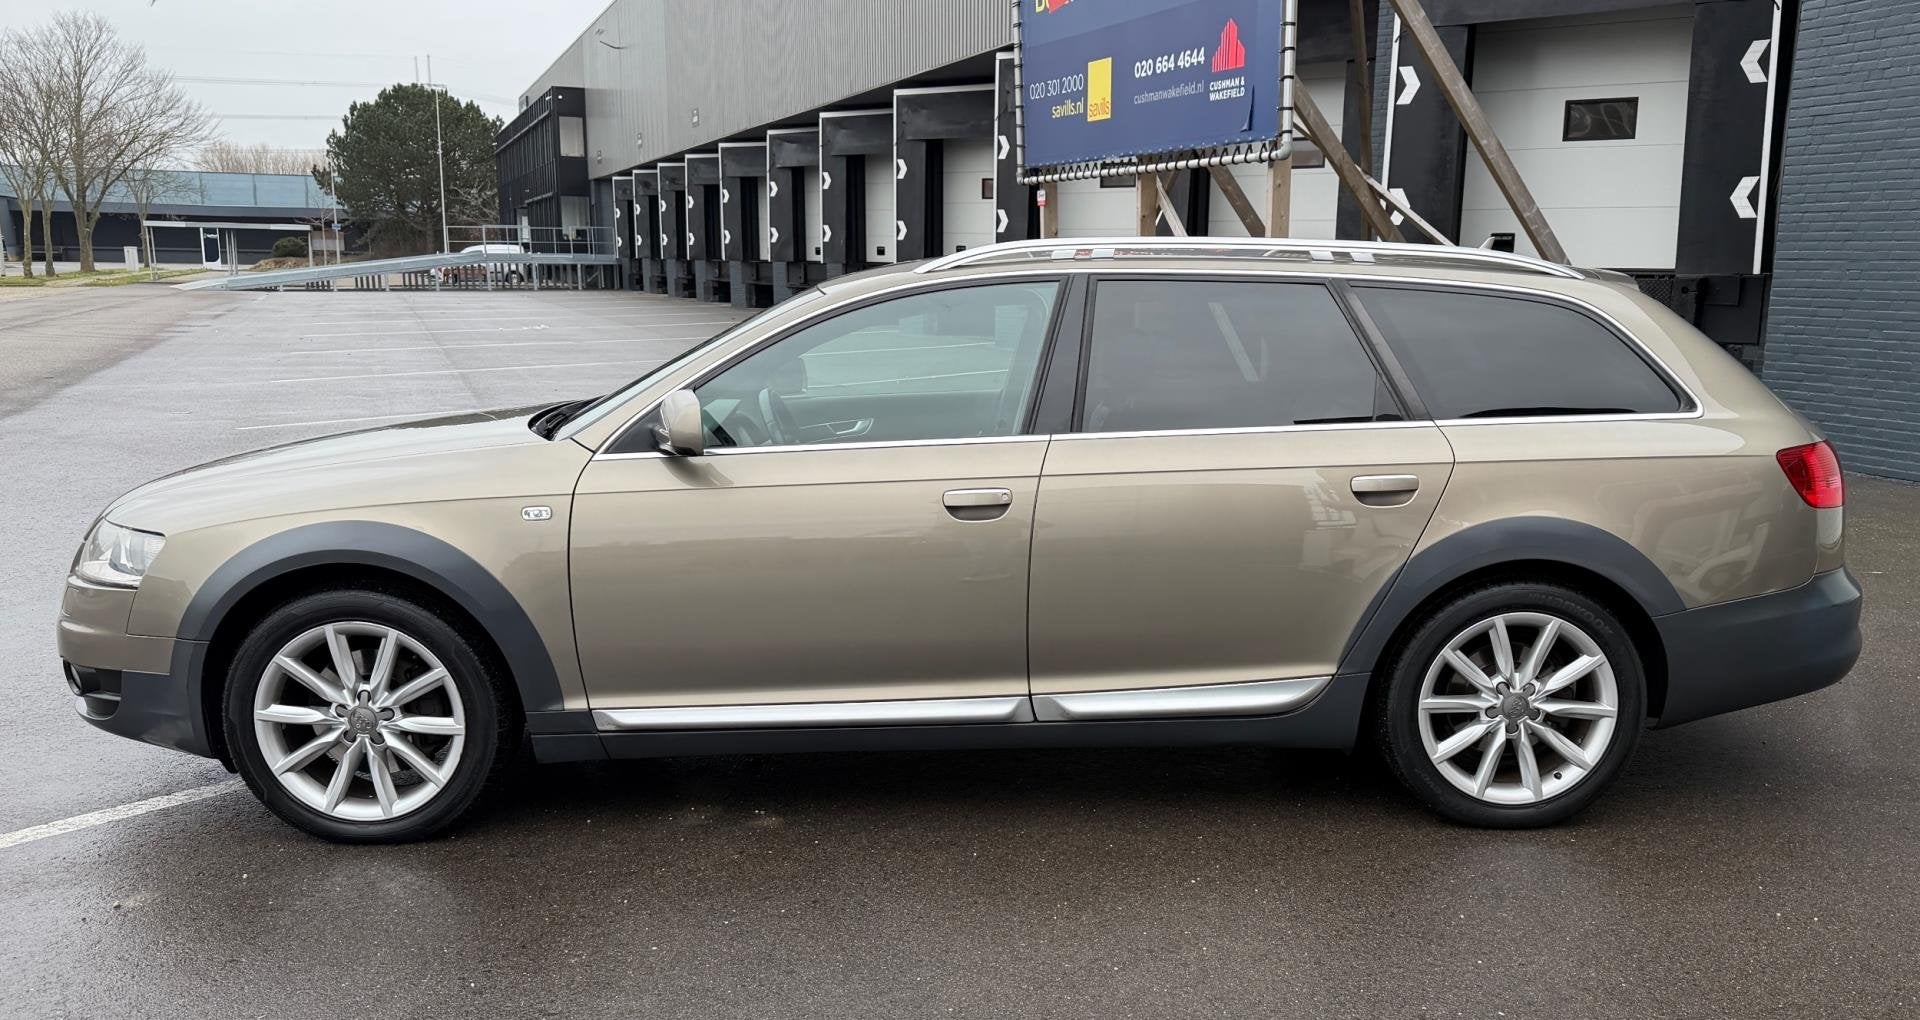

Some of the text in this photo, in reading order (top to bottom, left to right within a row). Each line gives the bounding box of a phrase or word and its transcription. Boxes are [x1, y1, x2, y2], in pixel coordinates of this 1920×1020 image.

[1134, 46, 1205, 79] 020 664 4644
[1029, 73, 1084, 100] 020 301 2000
[1133, 80, 1205, 105] cushmanwakefield.nl
[1209, 76, 1245, 91] CUSHMAN &
[1209, 87, 1246, 101] WAKEFIELD
[1051, 97, 1084, 118] savills.nl
[1088, 97, 1110, 118] savills
